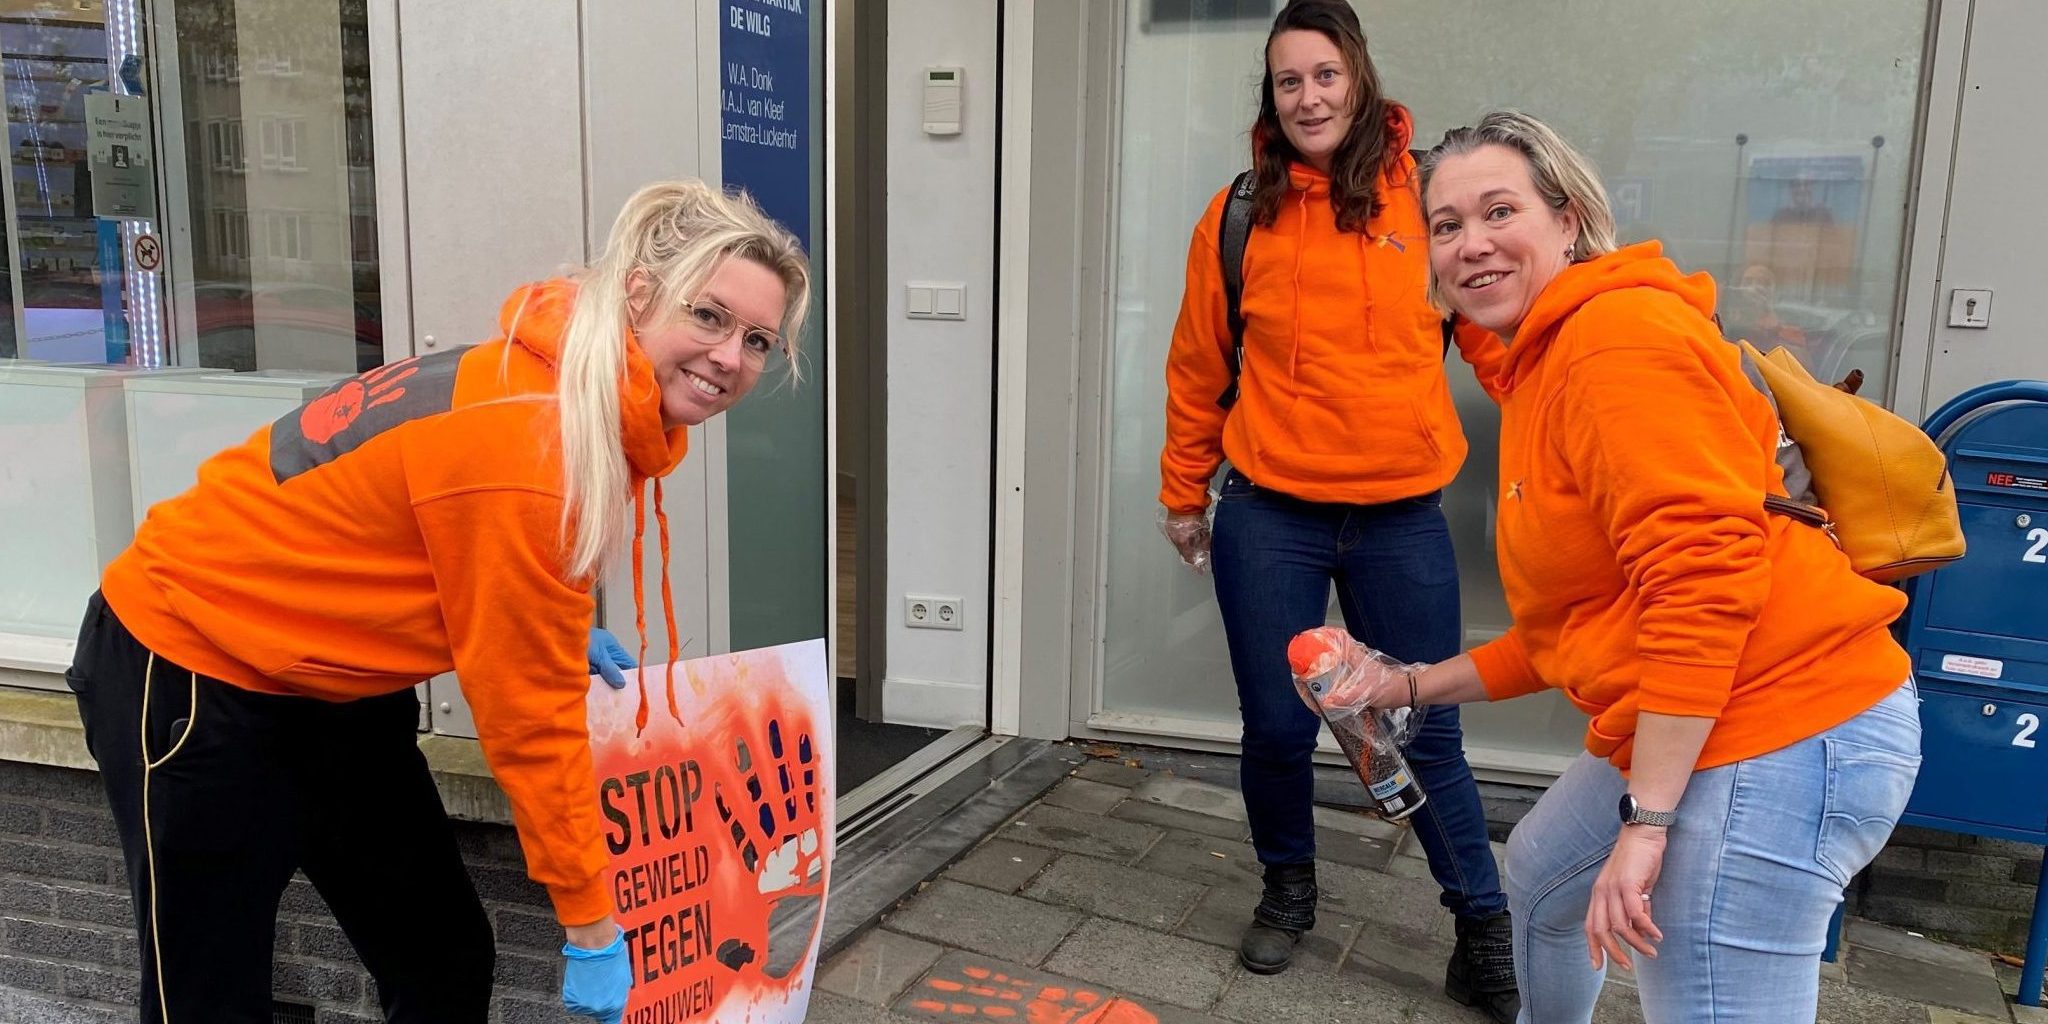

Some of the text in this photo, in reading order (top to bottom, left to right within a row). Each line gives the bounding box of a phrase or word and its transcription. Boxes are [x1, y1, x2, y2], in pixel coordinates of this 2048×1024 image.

[730, 6, 770, 37] DE WILG
[728, 61, 773, 92] W.A. Donk
[747, 99, 762, 117] van
[765, 97, 785, 121] Kleef
[721, 116, 797, 150] Lemstra-Luckerhof
[1988, 472, 2014, 487] NEE
[2022, 527, 2048, 564] 2
[2012, 713, 2040, 748] 2
[600, 760, 703, 856] STOP
[614, 845, 709, 914] GEWELD
[623, 900, 713, 990] TEGEN
